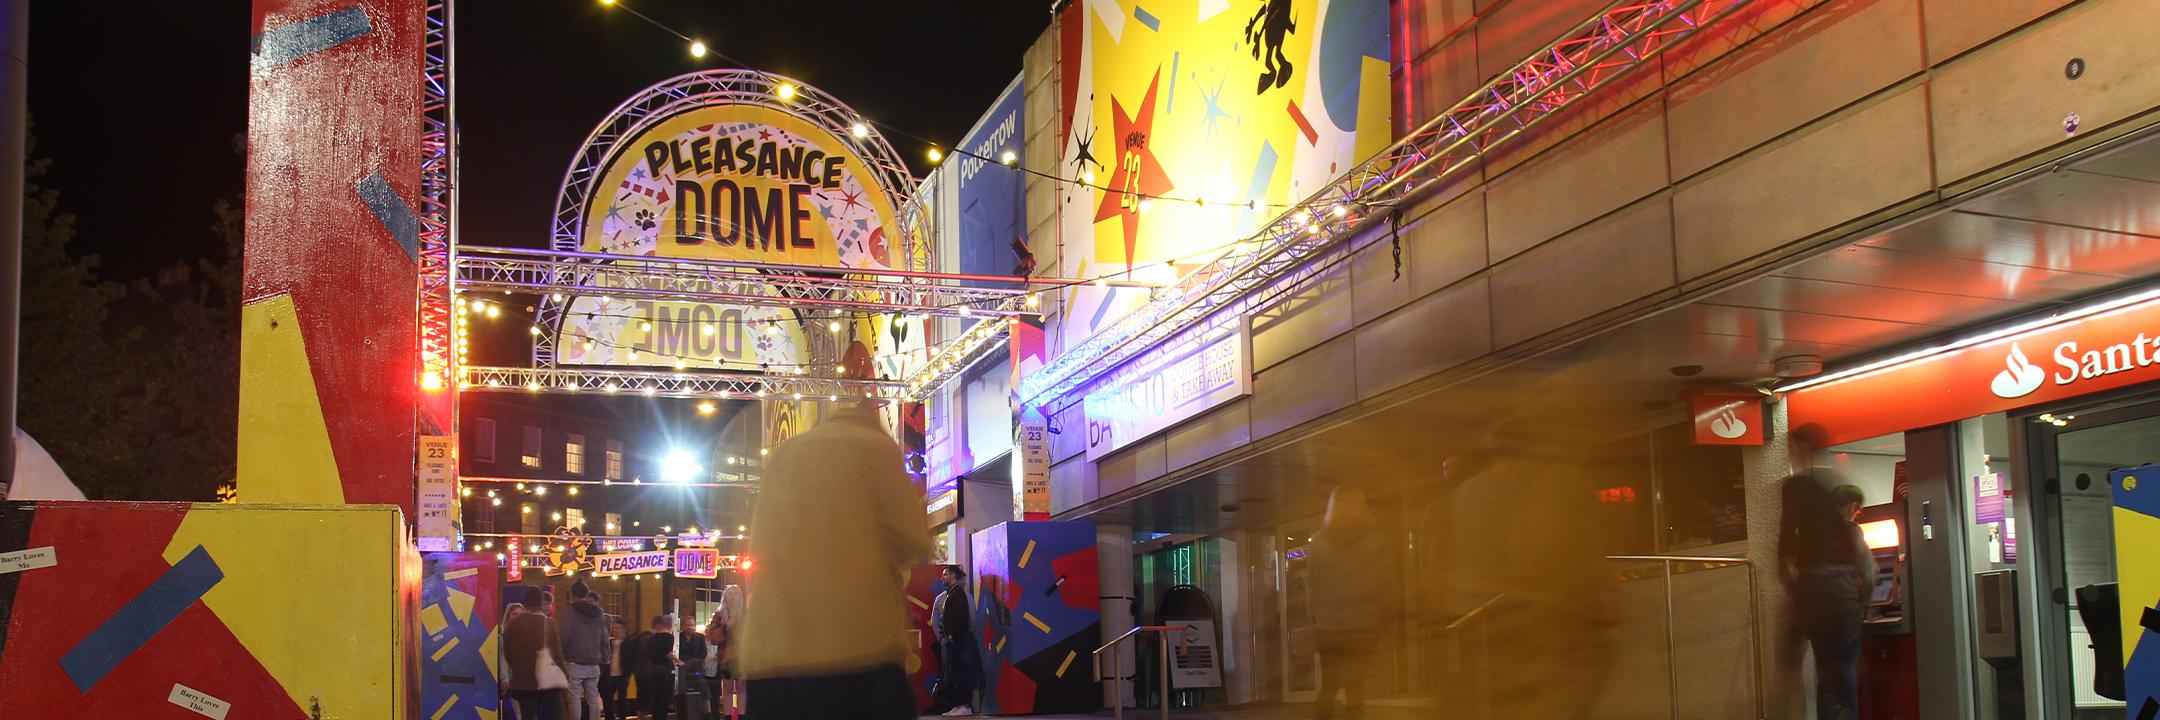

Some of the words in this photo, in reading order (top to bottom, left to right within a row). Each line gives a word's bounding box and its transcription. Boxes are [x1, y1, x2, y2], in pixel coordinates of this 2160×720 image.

[961, 108, 1016, 189] Potterrow
[1125, 132, 1145, 149] VENUE
[644, 137, 845, 189] PLEASANCE
[1121, 151, 1140, 213] 23
[675, 179, 816, 252] DOME
[1205, 340, 1233, 366] HOUSE
[1181, 374, 1204, 399] TAKE
[1206, 360, 1234, 389] AWAY
[1028, 432, 1041, 440] 23
[428, 448, 444, 458] 23
[600, 555, 665, 572] PLEASANCE
[680, 553, 712, 573] DOME
[181, 689, 198, 701] Barry
[200, 697, 219, 708] Loves
[190, 702, 203, 712] This
